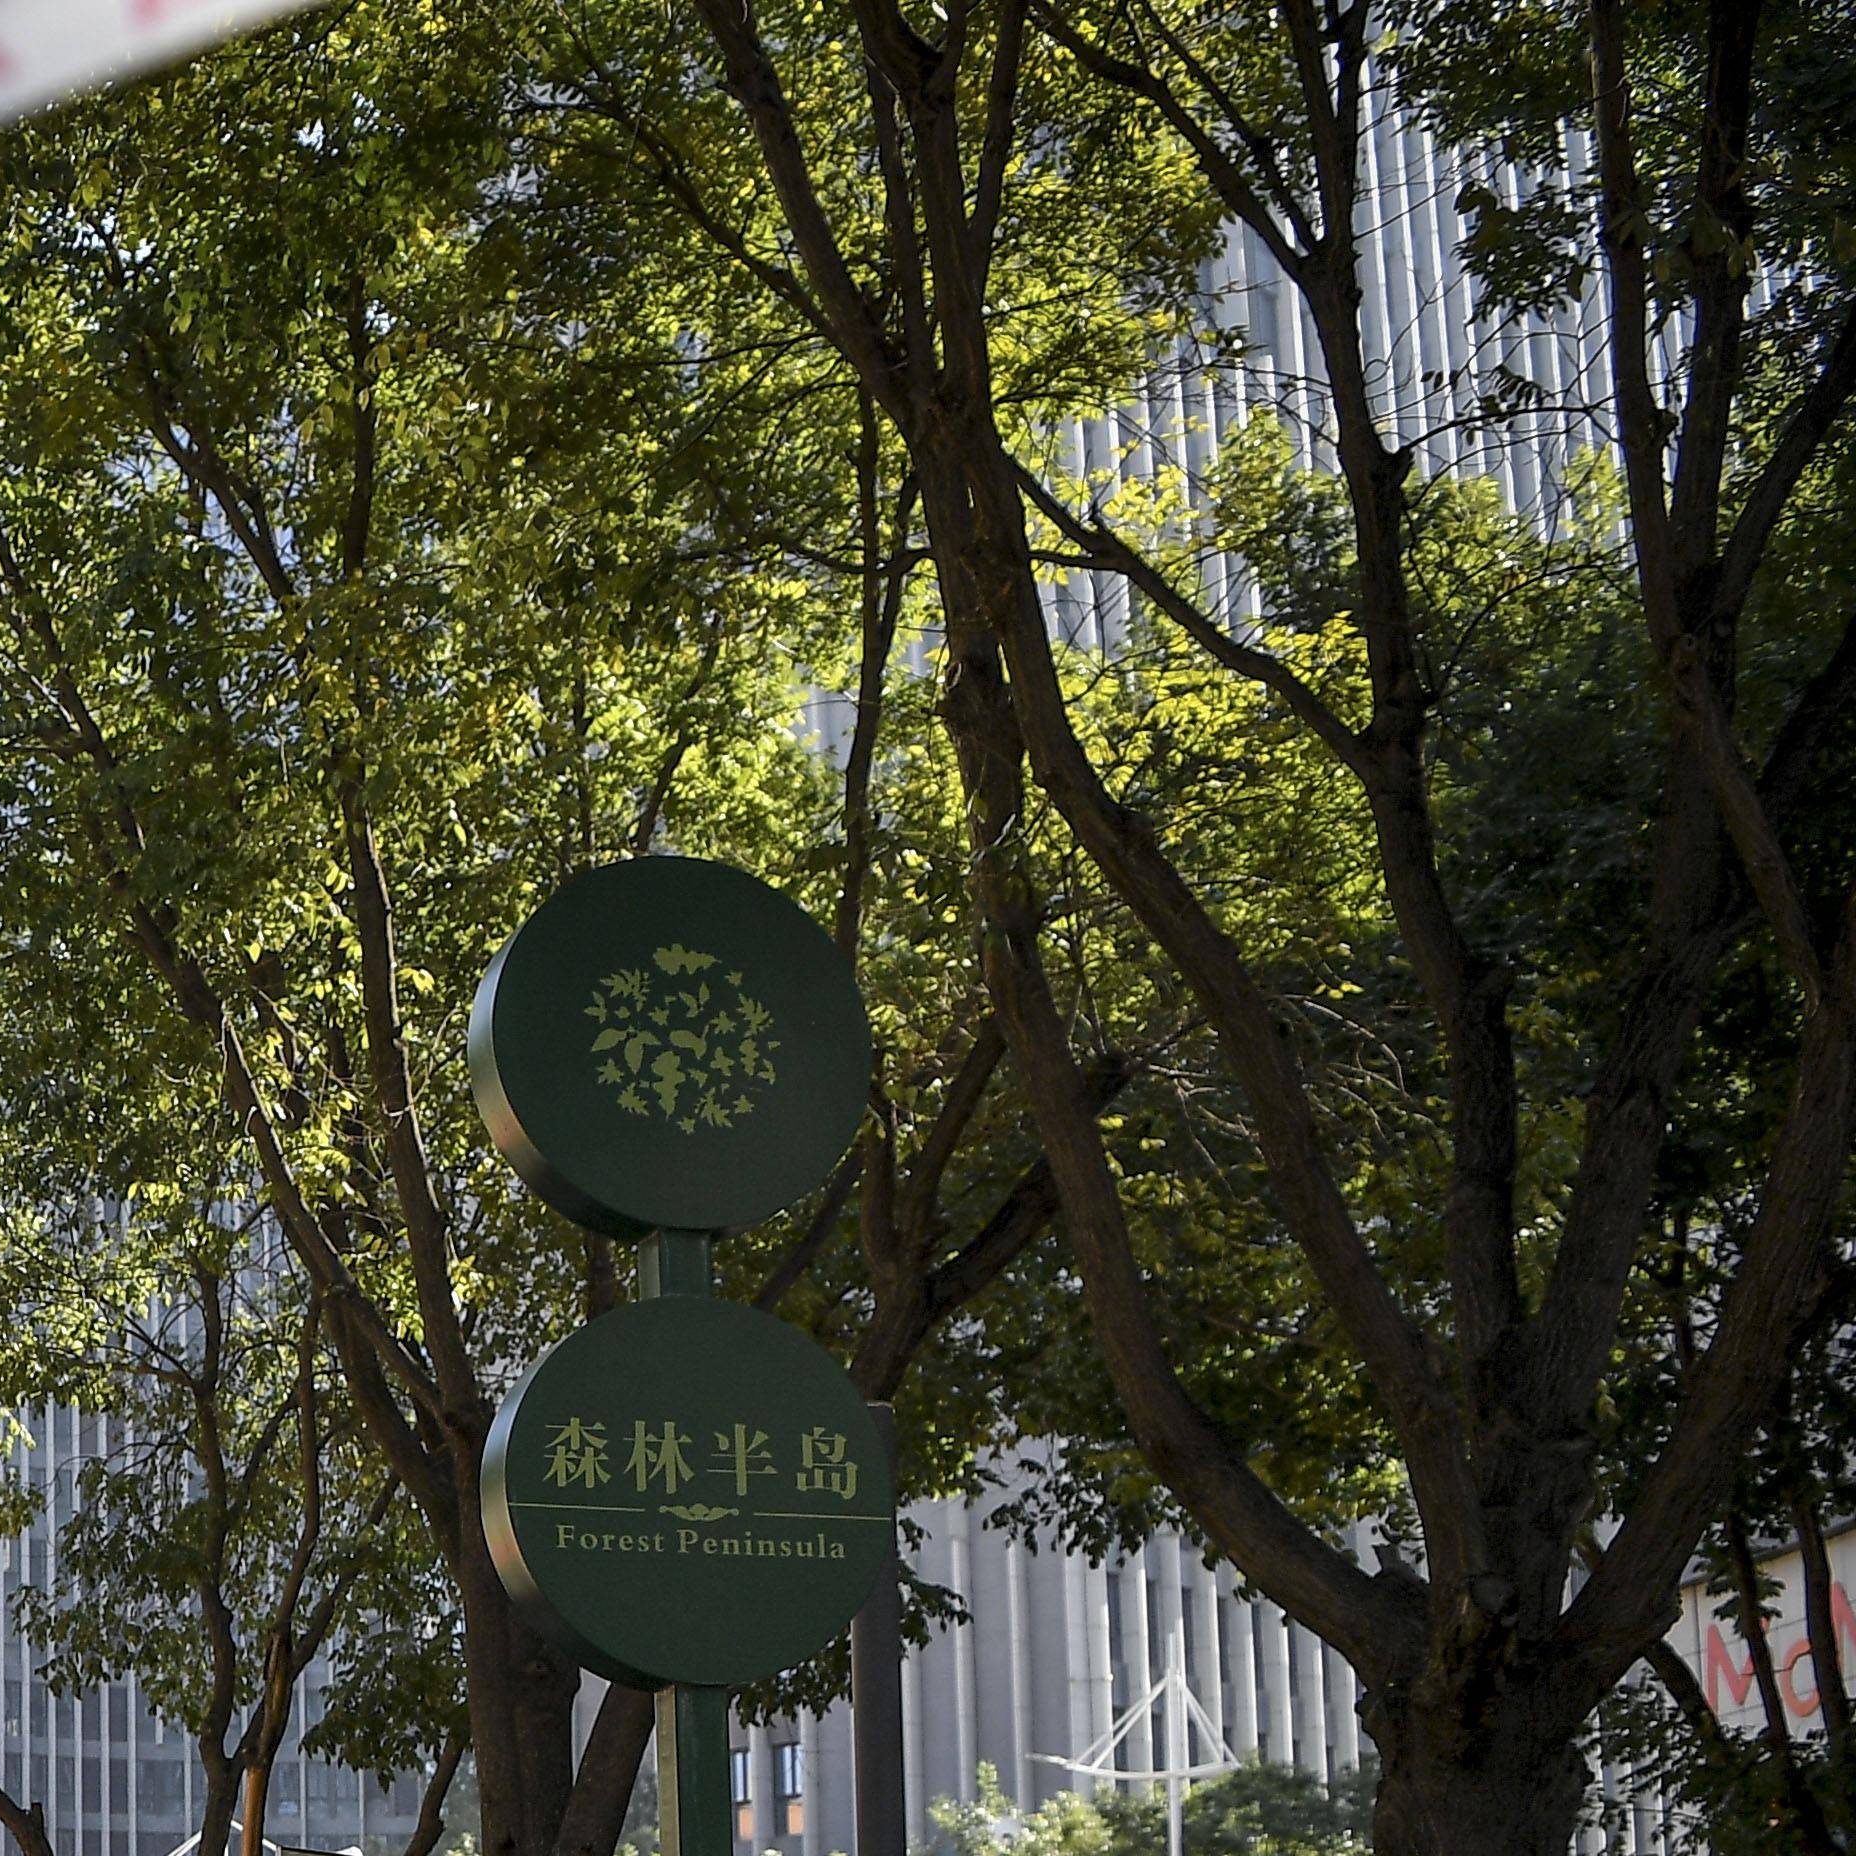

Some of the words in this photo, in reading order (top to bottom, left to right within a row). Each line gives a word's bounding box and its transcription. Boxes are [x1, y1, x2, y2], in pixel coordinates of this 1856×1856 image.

[542, 1416, 860, 1501] 森林半岛
[555, 1523, 667, 1556] Forest
[676, 1527, 847, 1561] Peninsula
